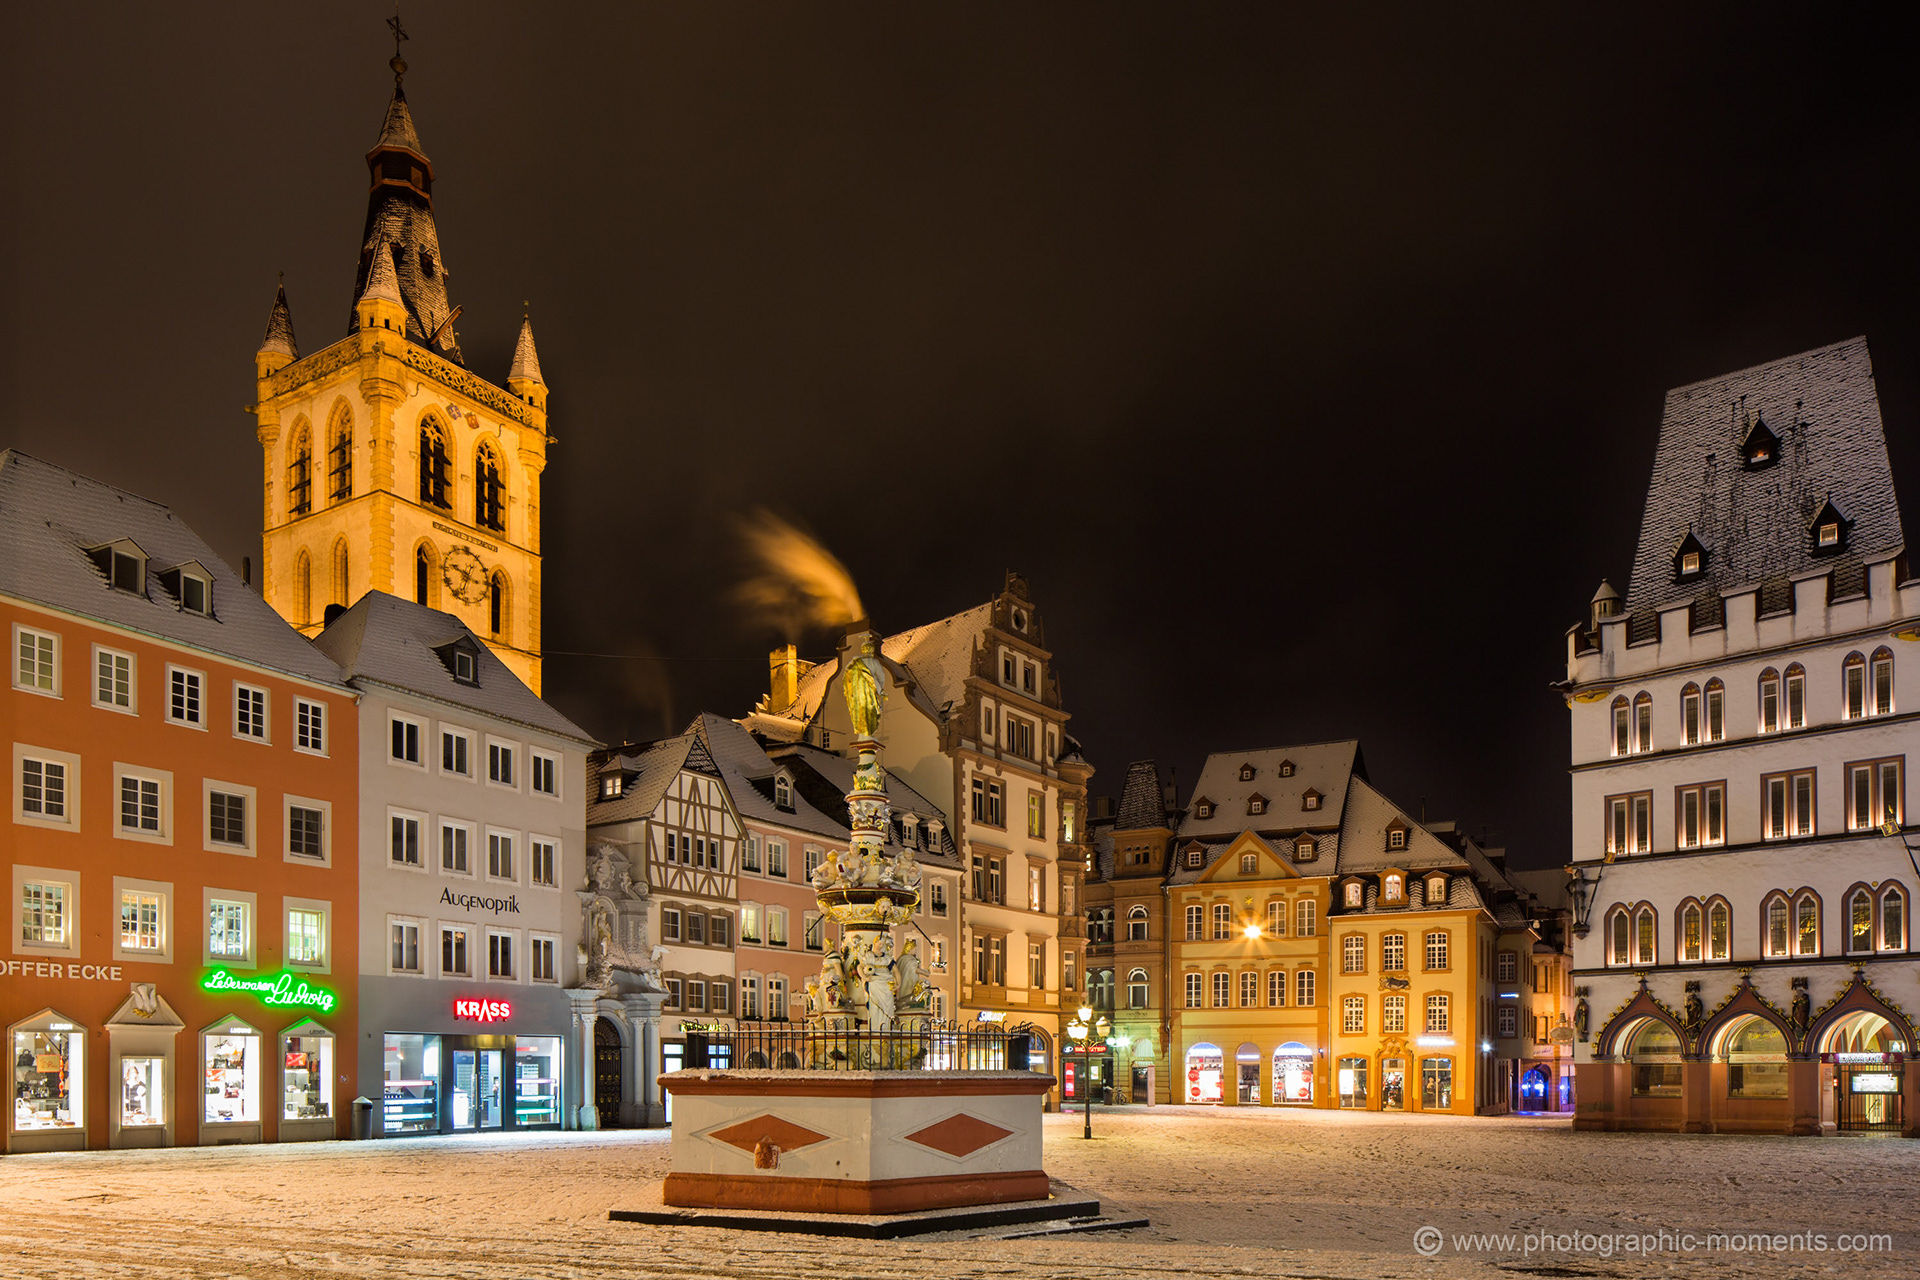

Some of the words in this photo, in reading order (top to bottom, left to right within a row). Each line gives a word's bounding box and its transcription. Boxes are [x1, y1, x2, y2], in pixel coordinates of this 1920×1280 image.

[67, 964, 122, 981] ECKE
[204, 970, 275, 991] Lederwaren
[264, 973, 334, 1011] Ludwig
[456, 998, 510, 1022] KRASS
